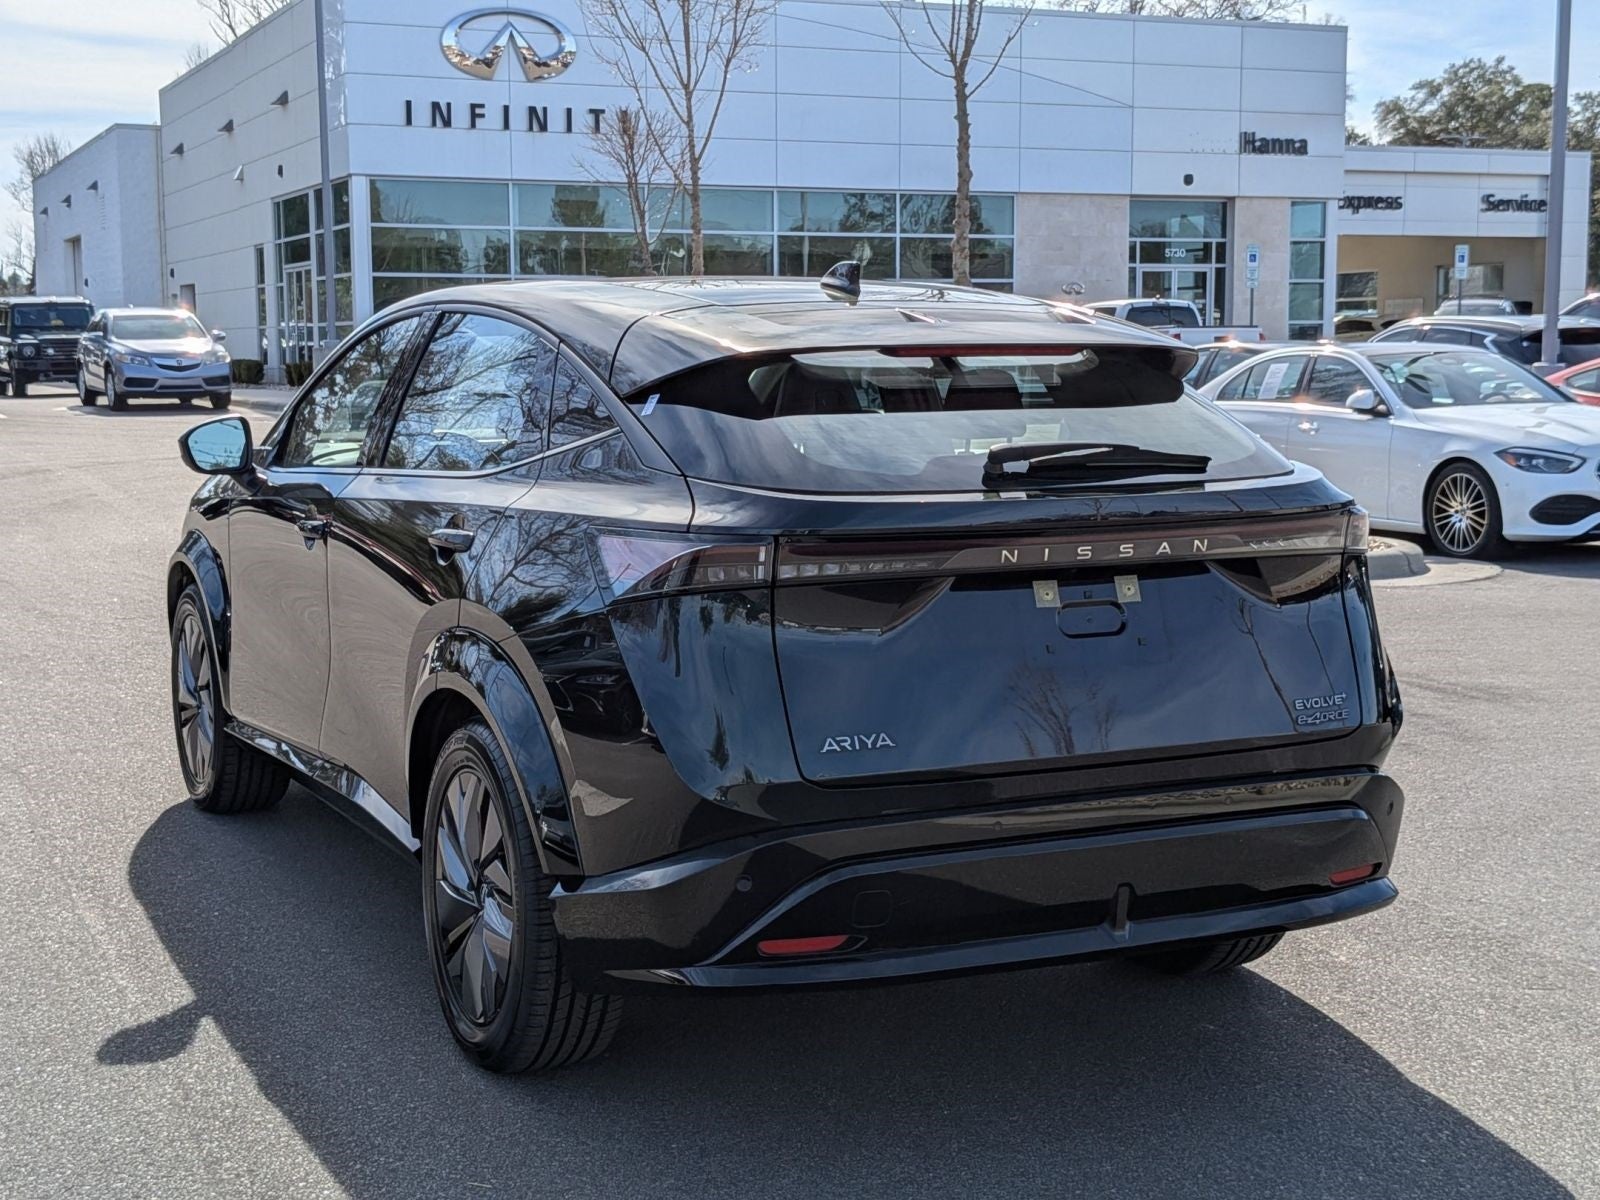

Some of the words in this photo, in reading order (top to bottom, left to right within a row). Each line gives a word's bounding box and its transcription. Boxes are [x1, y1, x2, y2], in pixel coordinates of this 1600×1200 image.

[1240, 131, 1308, 155] Hanna
[1480, 193, 1547, 213] Service
[1164, 248, 1186, 258] 5730
[1001, 539, 1208, 564] NISSAN
[820, 732, 896, 753] ARIYA
